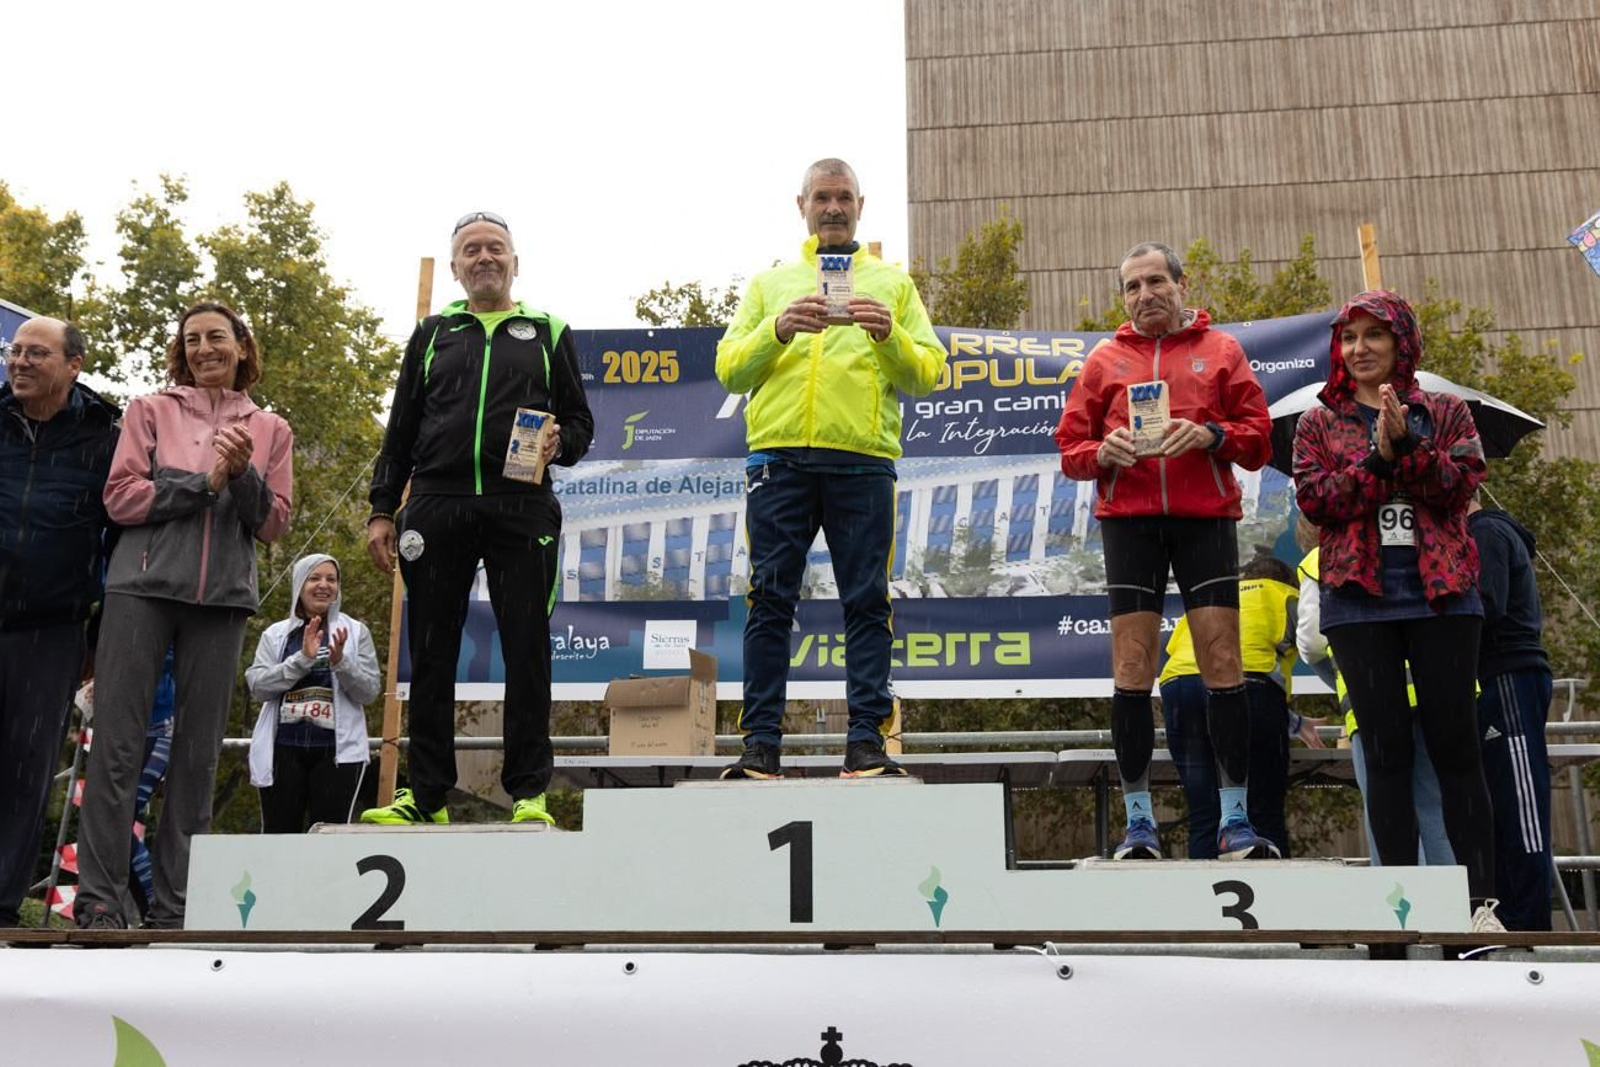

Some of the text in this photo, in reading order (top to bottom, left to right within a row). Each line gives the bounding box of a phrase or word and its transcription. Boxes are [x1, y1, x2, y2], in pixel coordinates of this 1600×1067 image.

[820, 256, 852, 271] XXV
[602, 350, 679, 383] 2025
[1249, 358, 1315, 374] Organiza
[1130, 384, 1163, 402] XXV
[915, 398, 983, 419] gran
[993, 391, 1066, 412] cami
[516, 413, 546, 430] XXV
[906, 419, 931, 442] la
[511, 439, 520, 454] 2
[552, 476, 746, 498] Catalina de Alejan
[1381, 508, 1414, 531] 96
[651, 634, 690, 644] Sierras
[767, 821, 813, 923] 1
[351, 854, 406, 931] 2
[1212, 880, 1258, 930] 3
